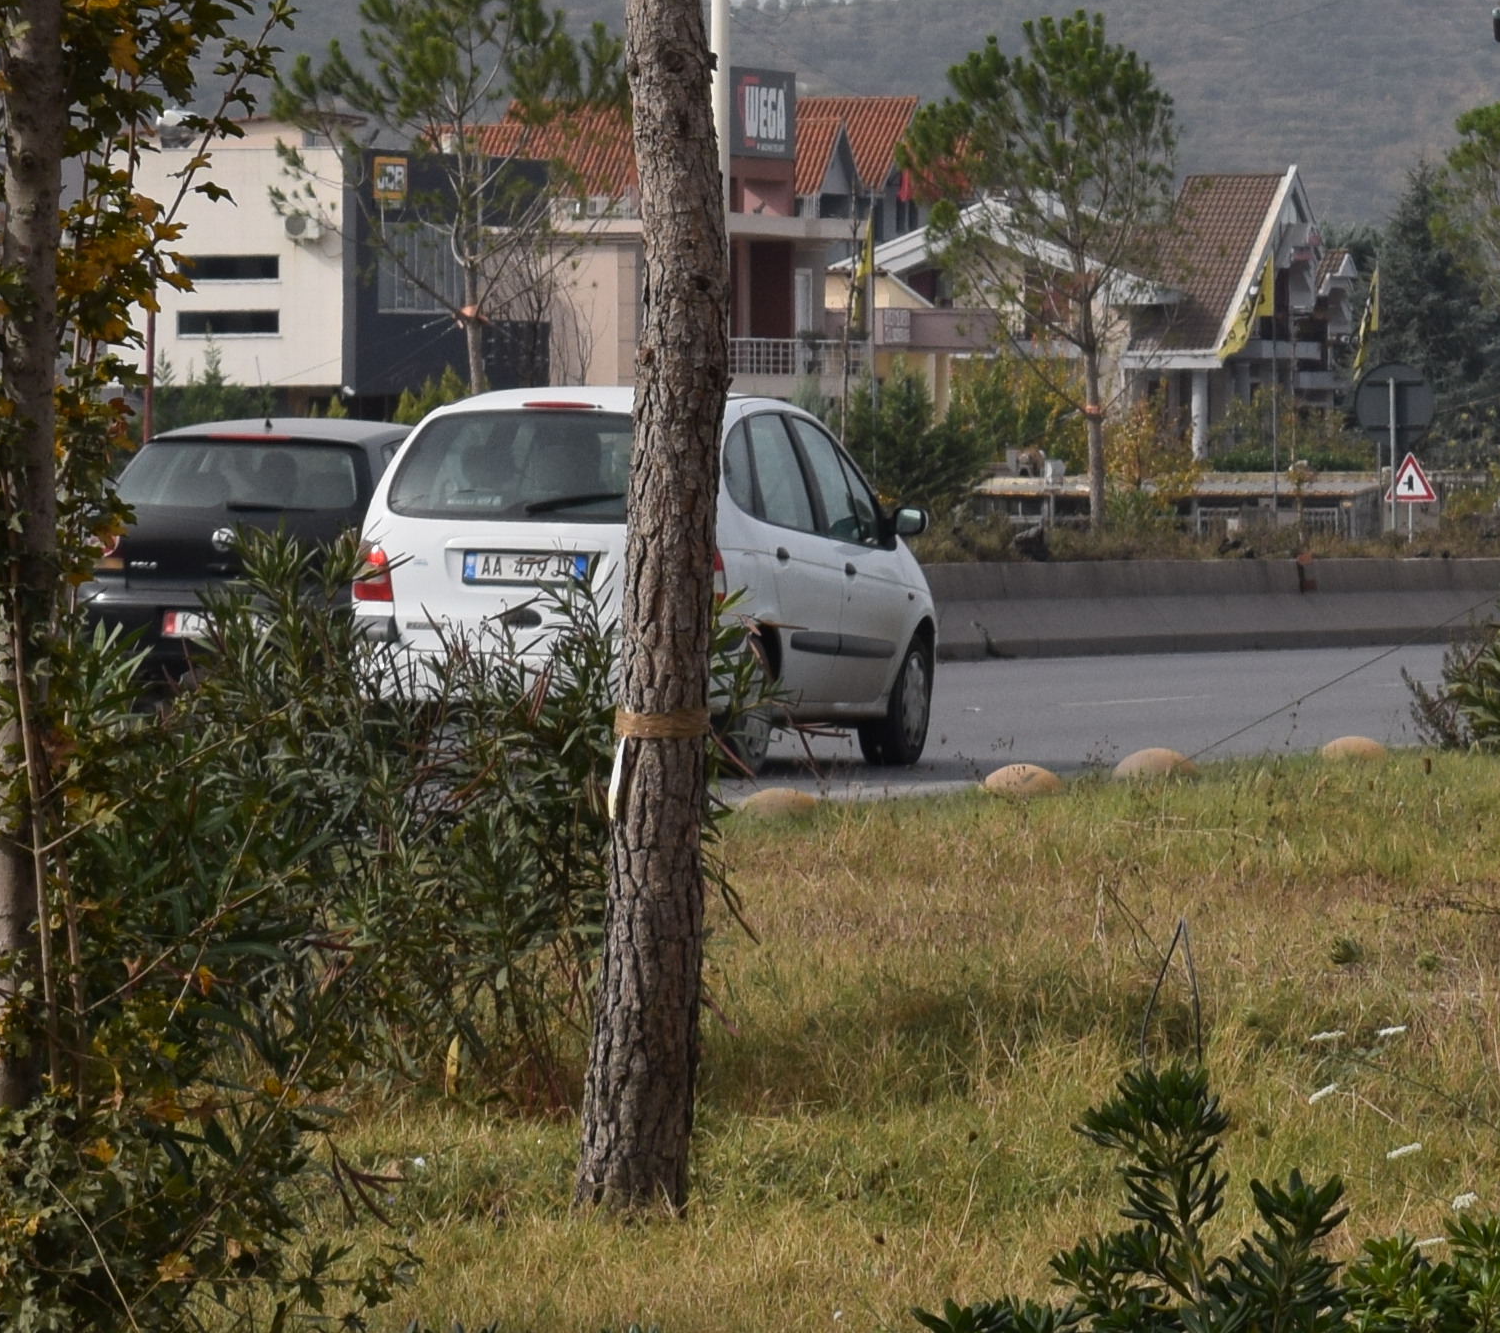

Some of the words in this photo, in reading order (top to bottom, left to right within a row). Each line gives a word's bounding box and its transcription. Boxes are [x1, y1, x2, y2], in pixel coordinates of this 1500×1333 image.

[745, 85, 786, 140] WEGA
[481, 556, 503, 576] AA
[514, 557, 548, 577] 479
